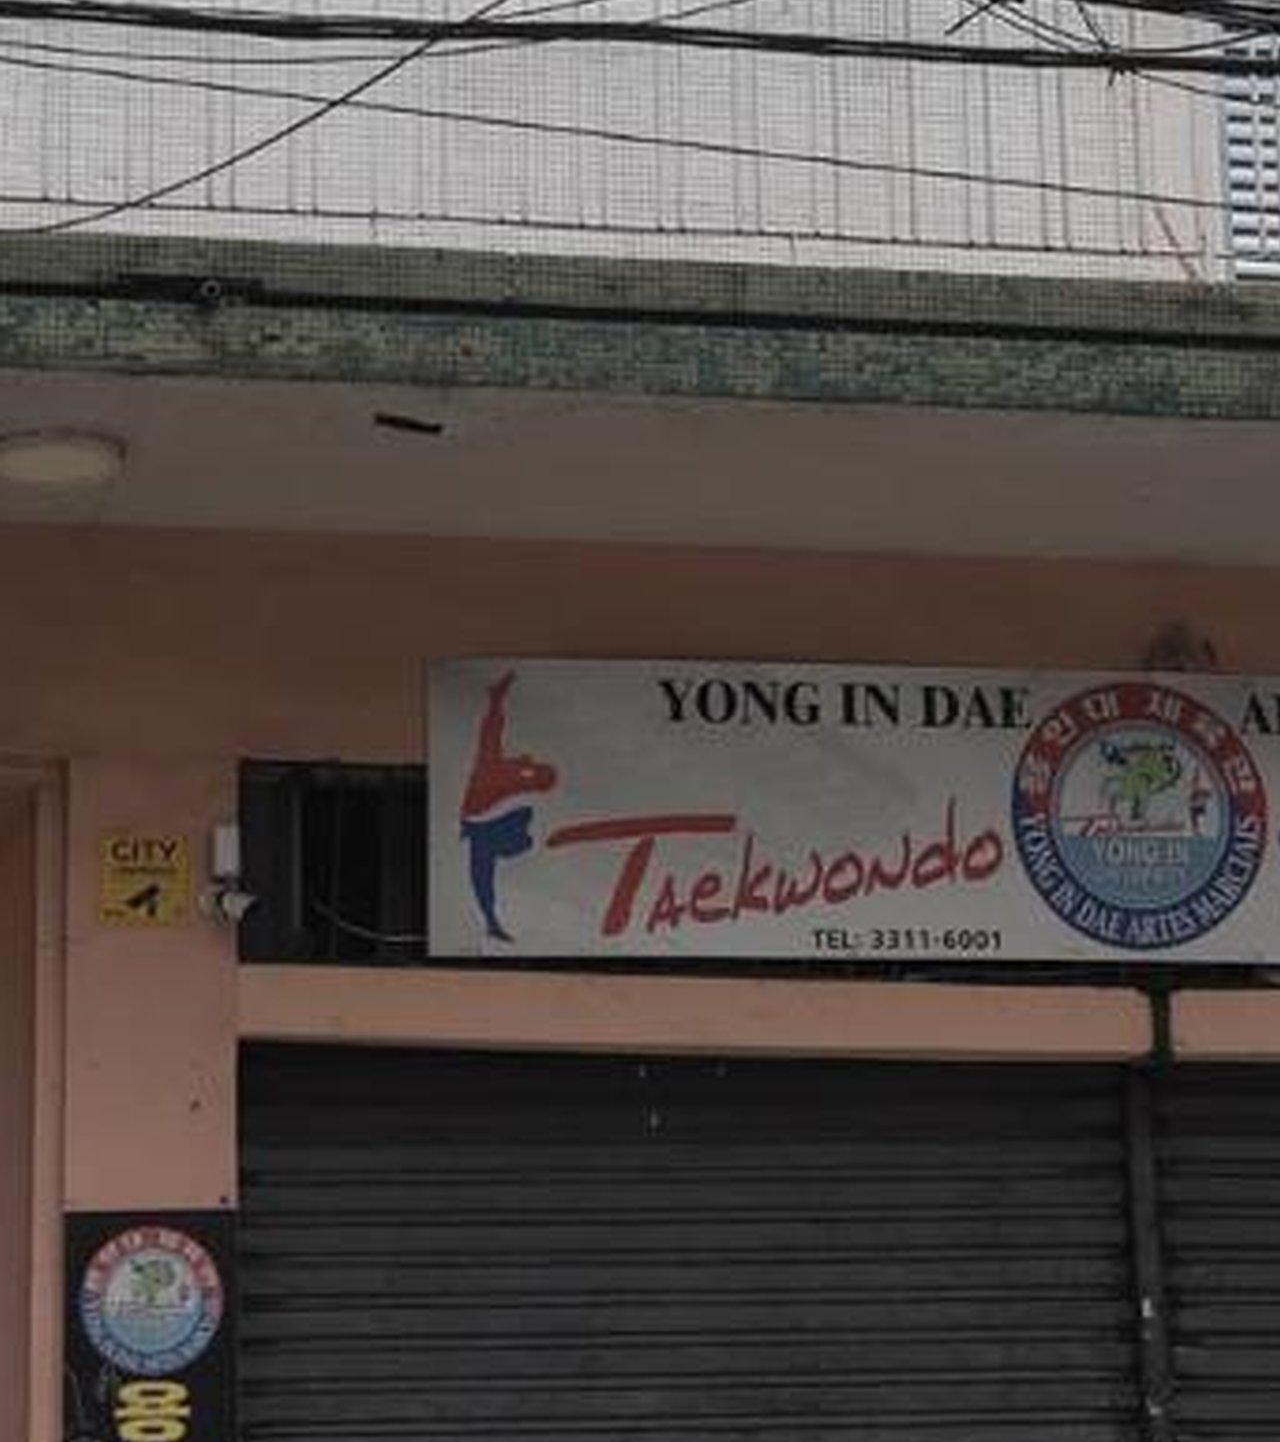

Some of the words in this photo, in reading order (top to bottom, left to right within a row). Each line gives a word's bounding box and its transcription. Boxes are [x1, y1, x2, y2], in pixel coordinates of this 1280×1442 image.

[658, 679, 820, 726] YONG
[840, 682, 903, 729] IN
[921, 684, 1033, 731] DAE
[110, 837, 179, 863] CITY
[813, 928, 859, 950] TEL:
[871, 928, 1002, 952] 3311-6001
